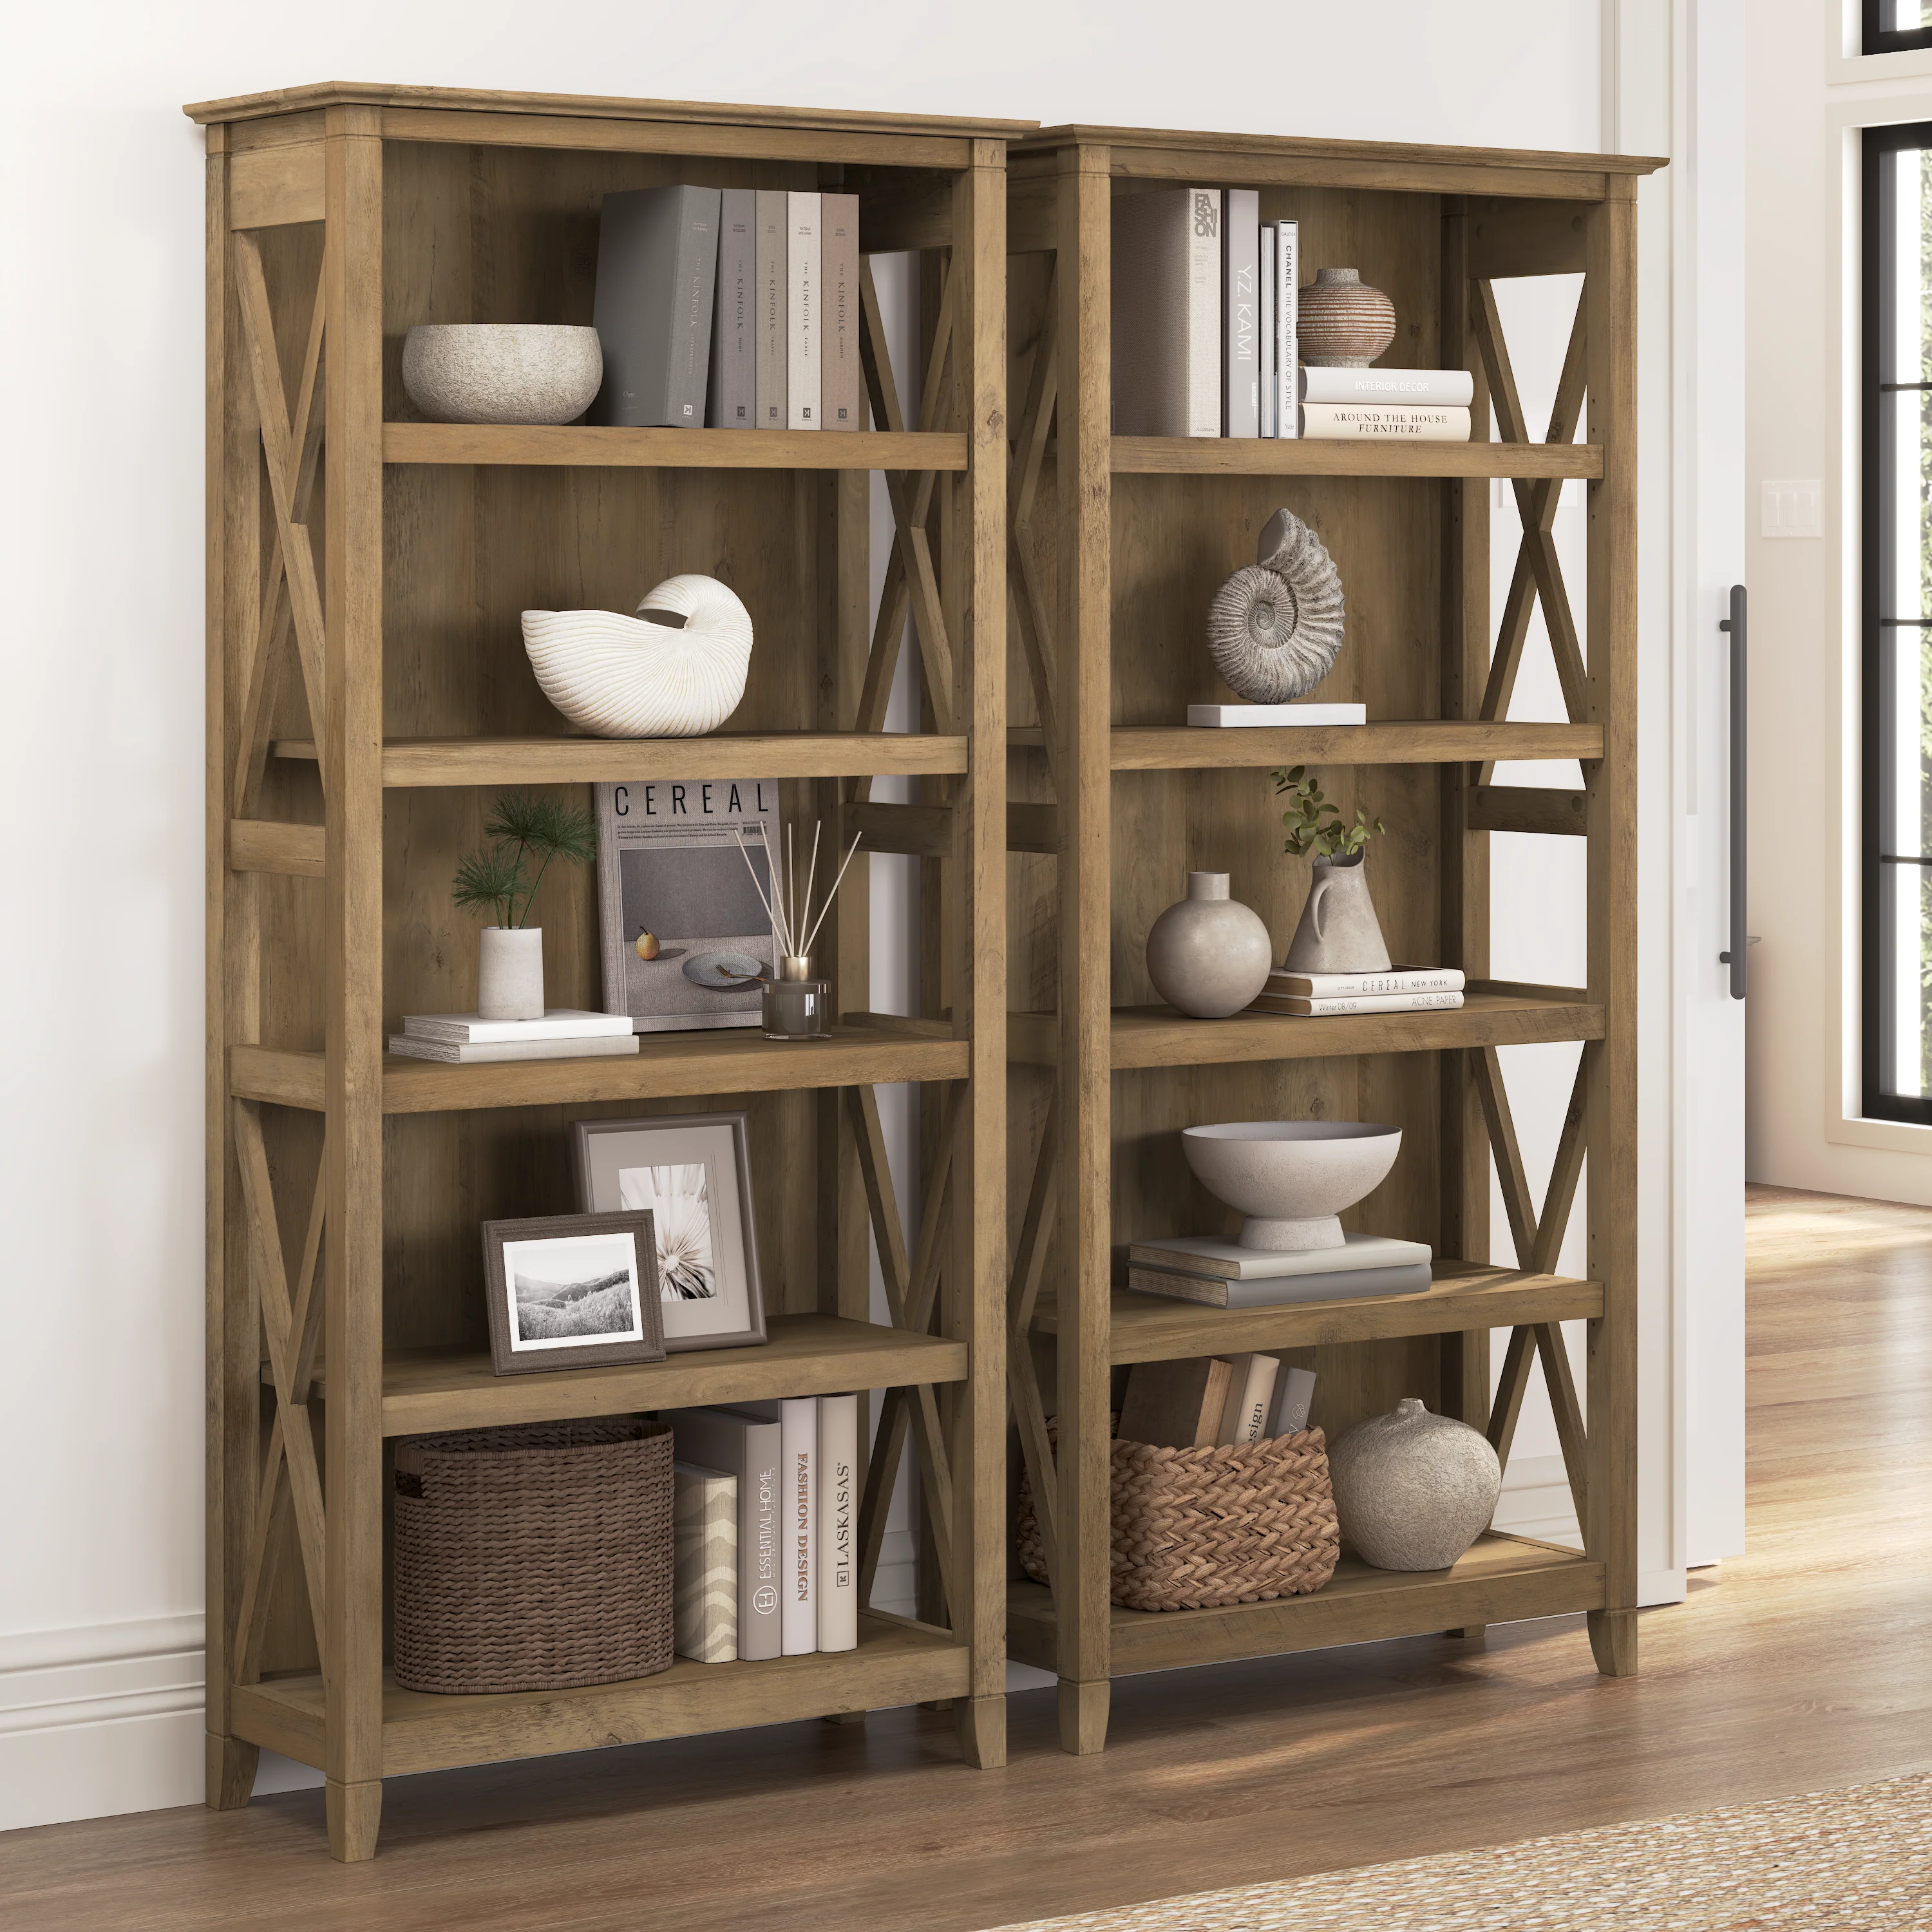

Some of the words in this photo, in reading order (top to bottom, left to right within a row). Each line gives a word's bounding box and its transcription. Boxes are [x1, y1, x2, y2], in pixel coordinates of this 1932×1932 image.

[1237, 264, 1252, 297] Y.Z.
[690, 277, 701, 327] KINFOLK
[1237, 304, 1252, 360] KAMI
[1285, 371, 1292, 382] OF
[1355, 381, 1397, 392] INTERIOR
[1399, 382, 1429, 392] DECOR
[1333, 413, 1380, 422] AROUND
[1385, 414, 1406, 422] THE
[1411, 415, 1448, 423] HOUSE
[1359, 424, 1422, 433] FURNITURE
[615, 783, 768, 816] CEREAL
[1363, 980, 1405, 992] CEREAL
[1338, 1001, 1357, 1011] 08/09
[1411, 996, 1433, 1006] ACNE
[1436, 995, 1456, 1005] PAPER
[759, 1469, 772, 1511] HOME
[798, 1454, 808, 1530] FASHION
[759, 1513, 772, 1580] ESSENTIAL
[798, 1535, 808, 1602] DESIGN
